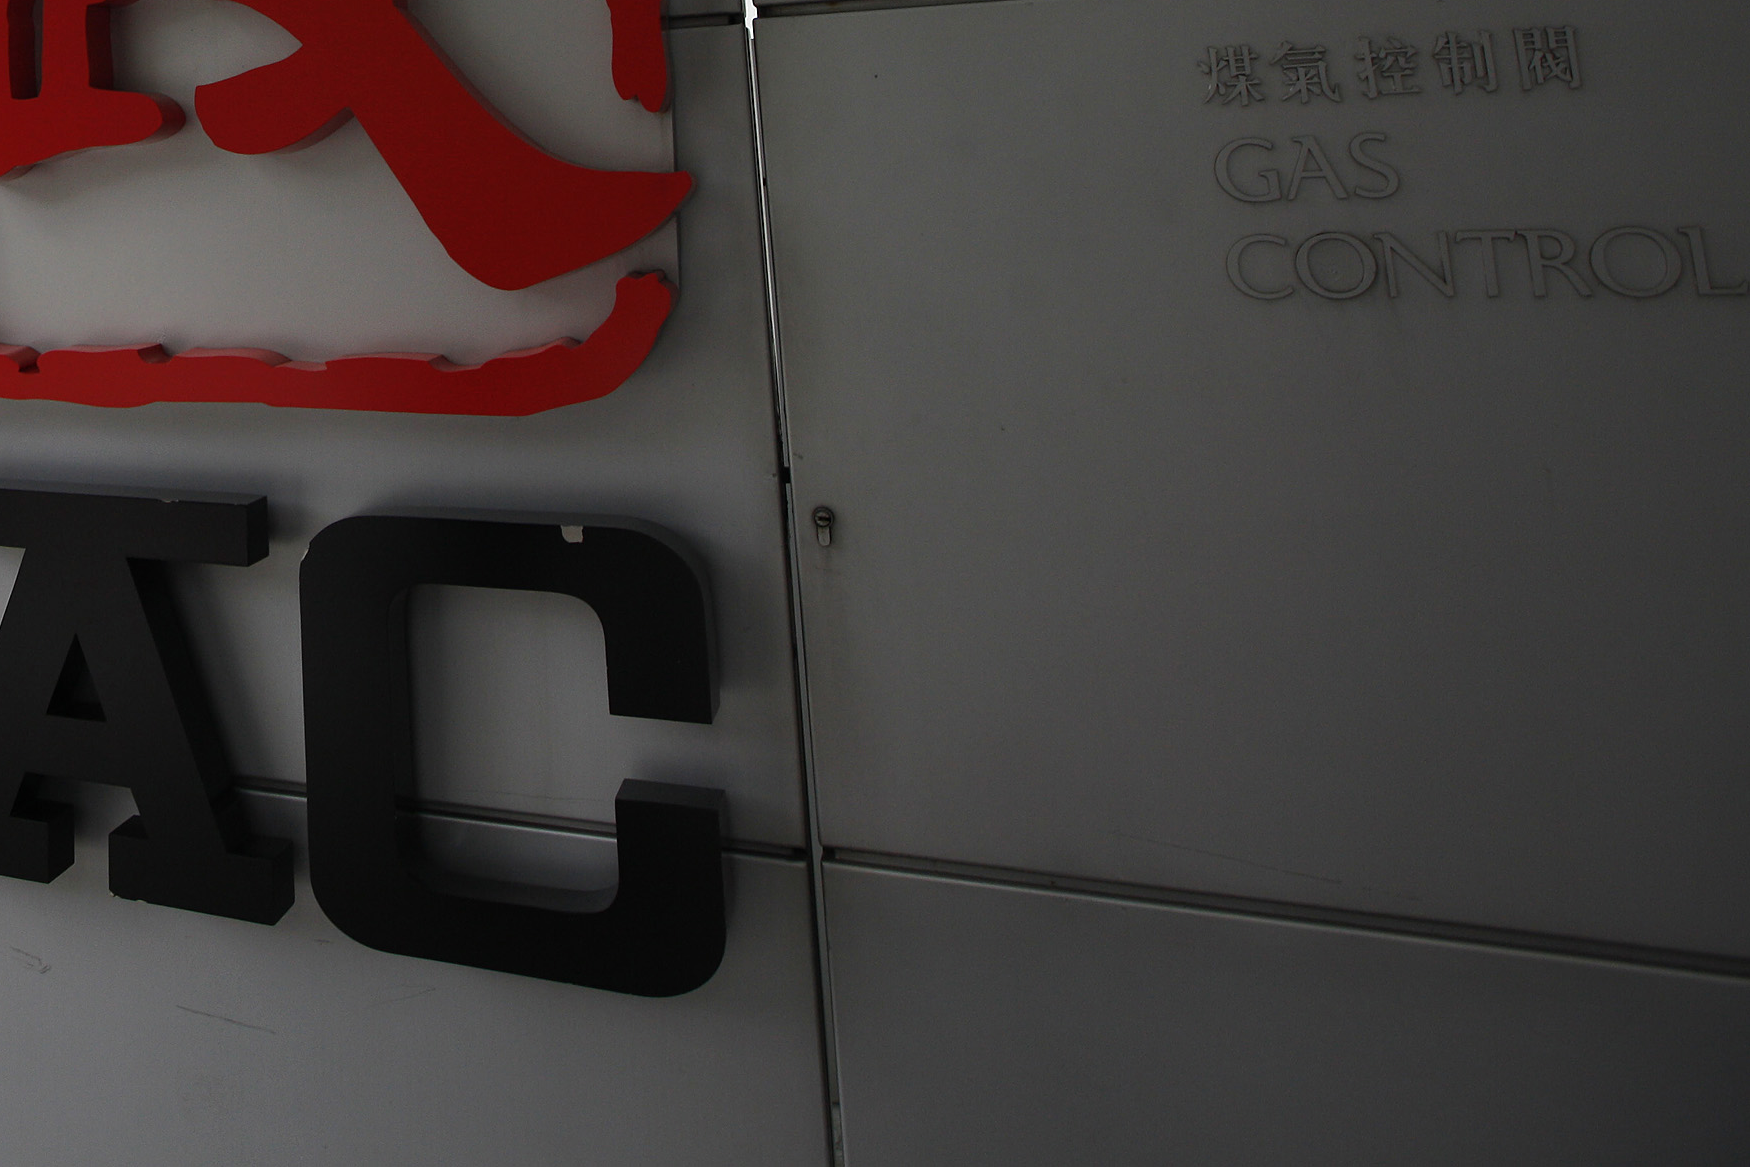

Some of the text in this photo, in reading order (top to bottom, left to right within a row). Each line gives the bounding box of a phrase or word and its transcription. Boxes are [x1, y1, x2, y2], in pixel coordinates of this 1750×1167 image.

[1199, 25, 1582, 106] 煤氣控制閥
[1213, 131, 1400, 202] GAS
[1225, 225, 1749, 300] CONTROL
